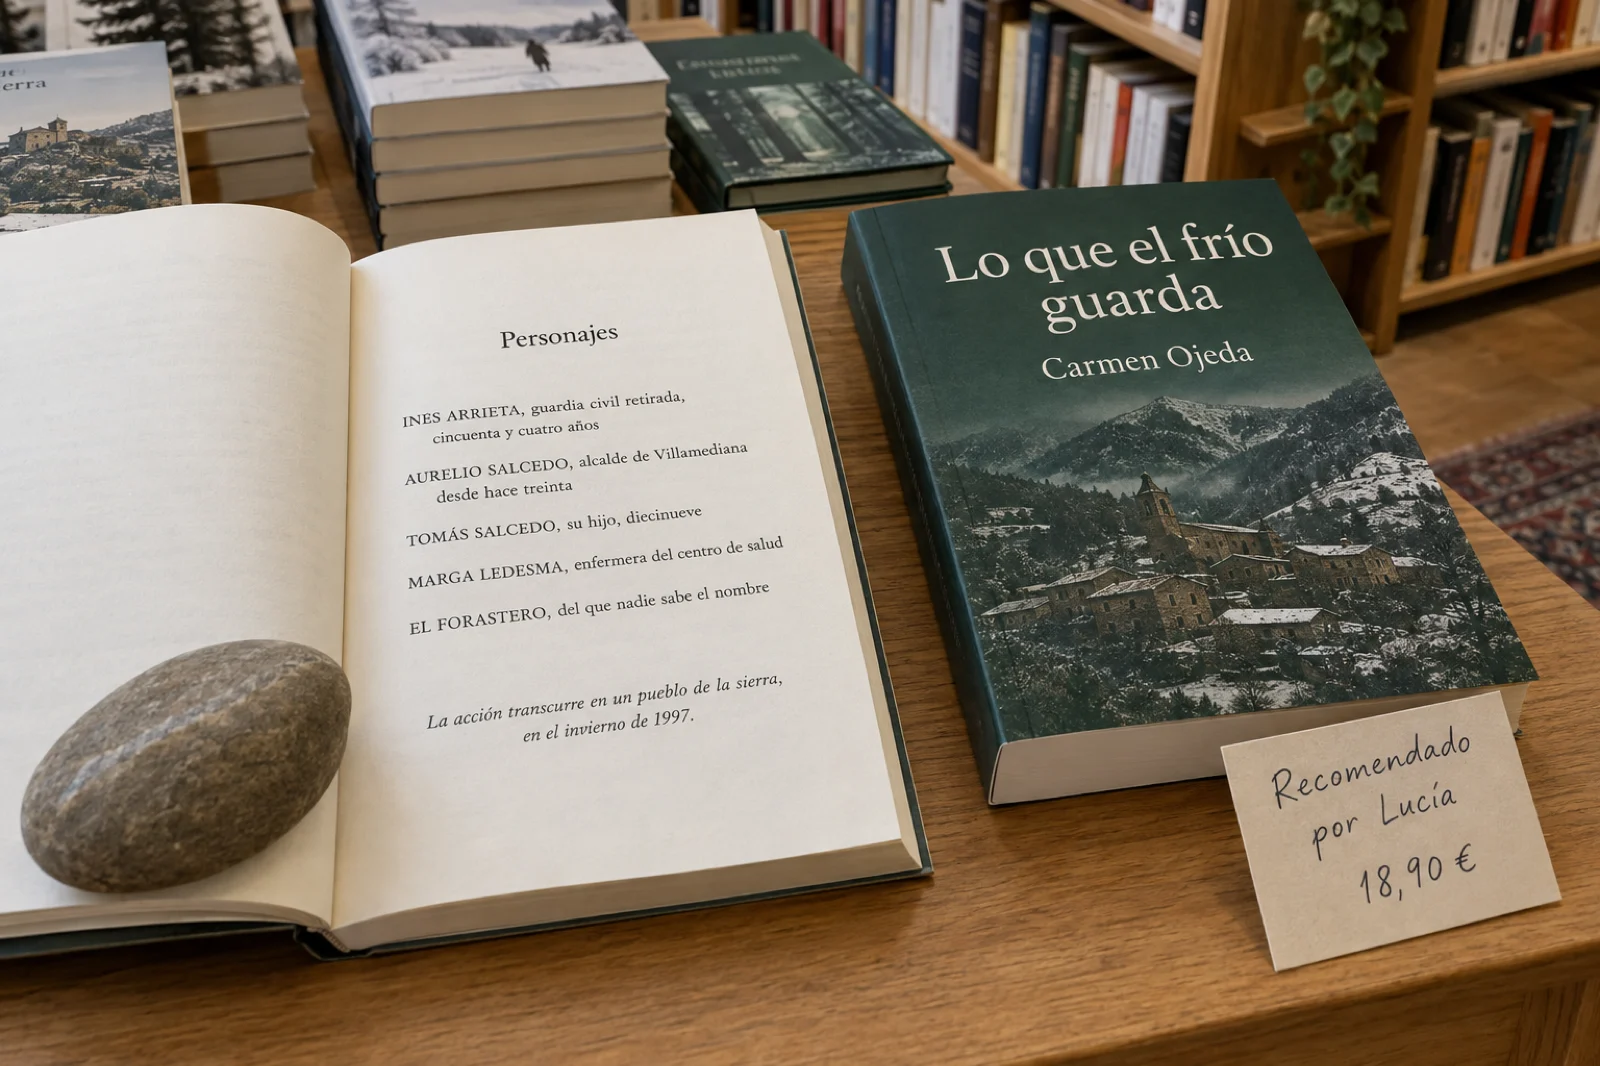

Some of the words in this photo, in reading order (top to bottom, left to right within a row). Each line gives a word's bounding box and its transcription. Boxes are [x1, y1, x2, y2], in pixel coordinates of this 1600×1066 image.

[2, 80, 47, 91] erra
[934, 245, 1011, 284] Lo
[1023, 240, 1119, 284] que
[1128, 225, 1176, 265] el
[1180, 222, 1274, 262] frío
[1041, 272, 1224, 335] guarda
[499, 323, 619, 350] Personajes
[1041, 353, 1161, 381] Carmen
[1166, 341, 1255, 374] Ojeda
[446, 404, 525, 423] ARRIETA,
[530, 399, 586, 418] guardia
[589, 394, 621, 410] civil
[624, 389, 686, 407] retirada,
[432, 429, 502, 445] cincuenta
[504, 428, 514, 441] y
[517, 424, 563, 437] cuatro
[567, 419, 600, 433] años
[404, 465, 482, 486] AURELIO
[487, 457, 574, 477] SALCEDO,
[578, 451, 628, 468] alcalde
[632, 449, 651, 463] de
[653, 442, 749, 460] Villamediana
[436, 487, 479, 504] desde
[483, 485, 519, 499] hace
[523, 480, 574, 496] treinta
[405, 526, 469, 548] TOMÁS
[474, 519, 561, 539] SALCEDO,
[566, 519, 584, 531] su
[586, 513, 621, 531] hijo,
[625, 507, 703, 525] diecinueve
[407, 569, 475, 590] MARGA
[479, 560, 569, 581] LEDESMA,
[574, 554, 648, 571] enfermera
[651, 547, 674, 563] del
[677, 546, 723, 560] centro
[726, 540, 744, 555] de
[747, 535, 784, 552] salud
[409, 620, 432, 636] EL
[436, 606, 552, 632] FORASTERO,
[557, 601, 581, 617] del
[584, 602, 612, 617] que
[616, 593, 657, 611] nadie
[660, 589, 693, 605] sabe
[696, 586, 710, 601] el
[714, 581, 770, 599] nombre
[426, 714, 449, 730] La
[453, 706, 503, 726] acción
[508, 699, 585, 719] transcurre
[589, 696, 608, 708] en
[612, 693, 633, 706] un
[636, 682, 688, 707] pueblo
[693, 679, 711, 696] de
[716, 677, 731, 692] la
[735, 674, 783, 690] sierra,
[522, 731, 542, 743] en
[545, 723, 559, 740] el
[564, 719, 626, 738] invierno
[630, 712, 649, 729] de
[653, 708, 694, 727] 1997.
[1271, 725, 1471, 810] Recomendado
[1312, 816, 1359, 862] por
[1380, 781, 1458, 826] Lucía
[1359, 856, 1443, 904] 18,90
[1454, 843, 1477, 873] €
